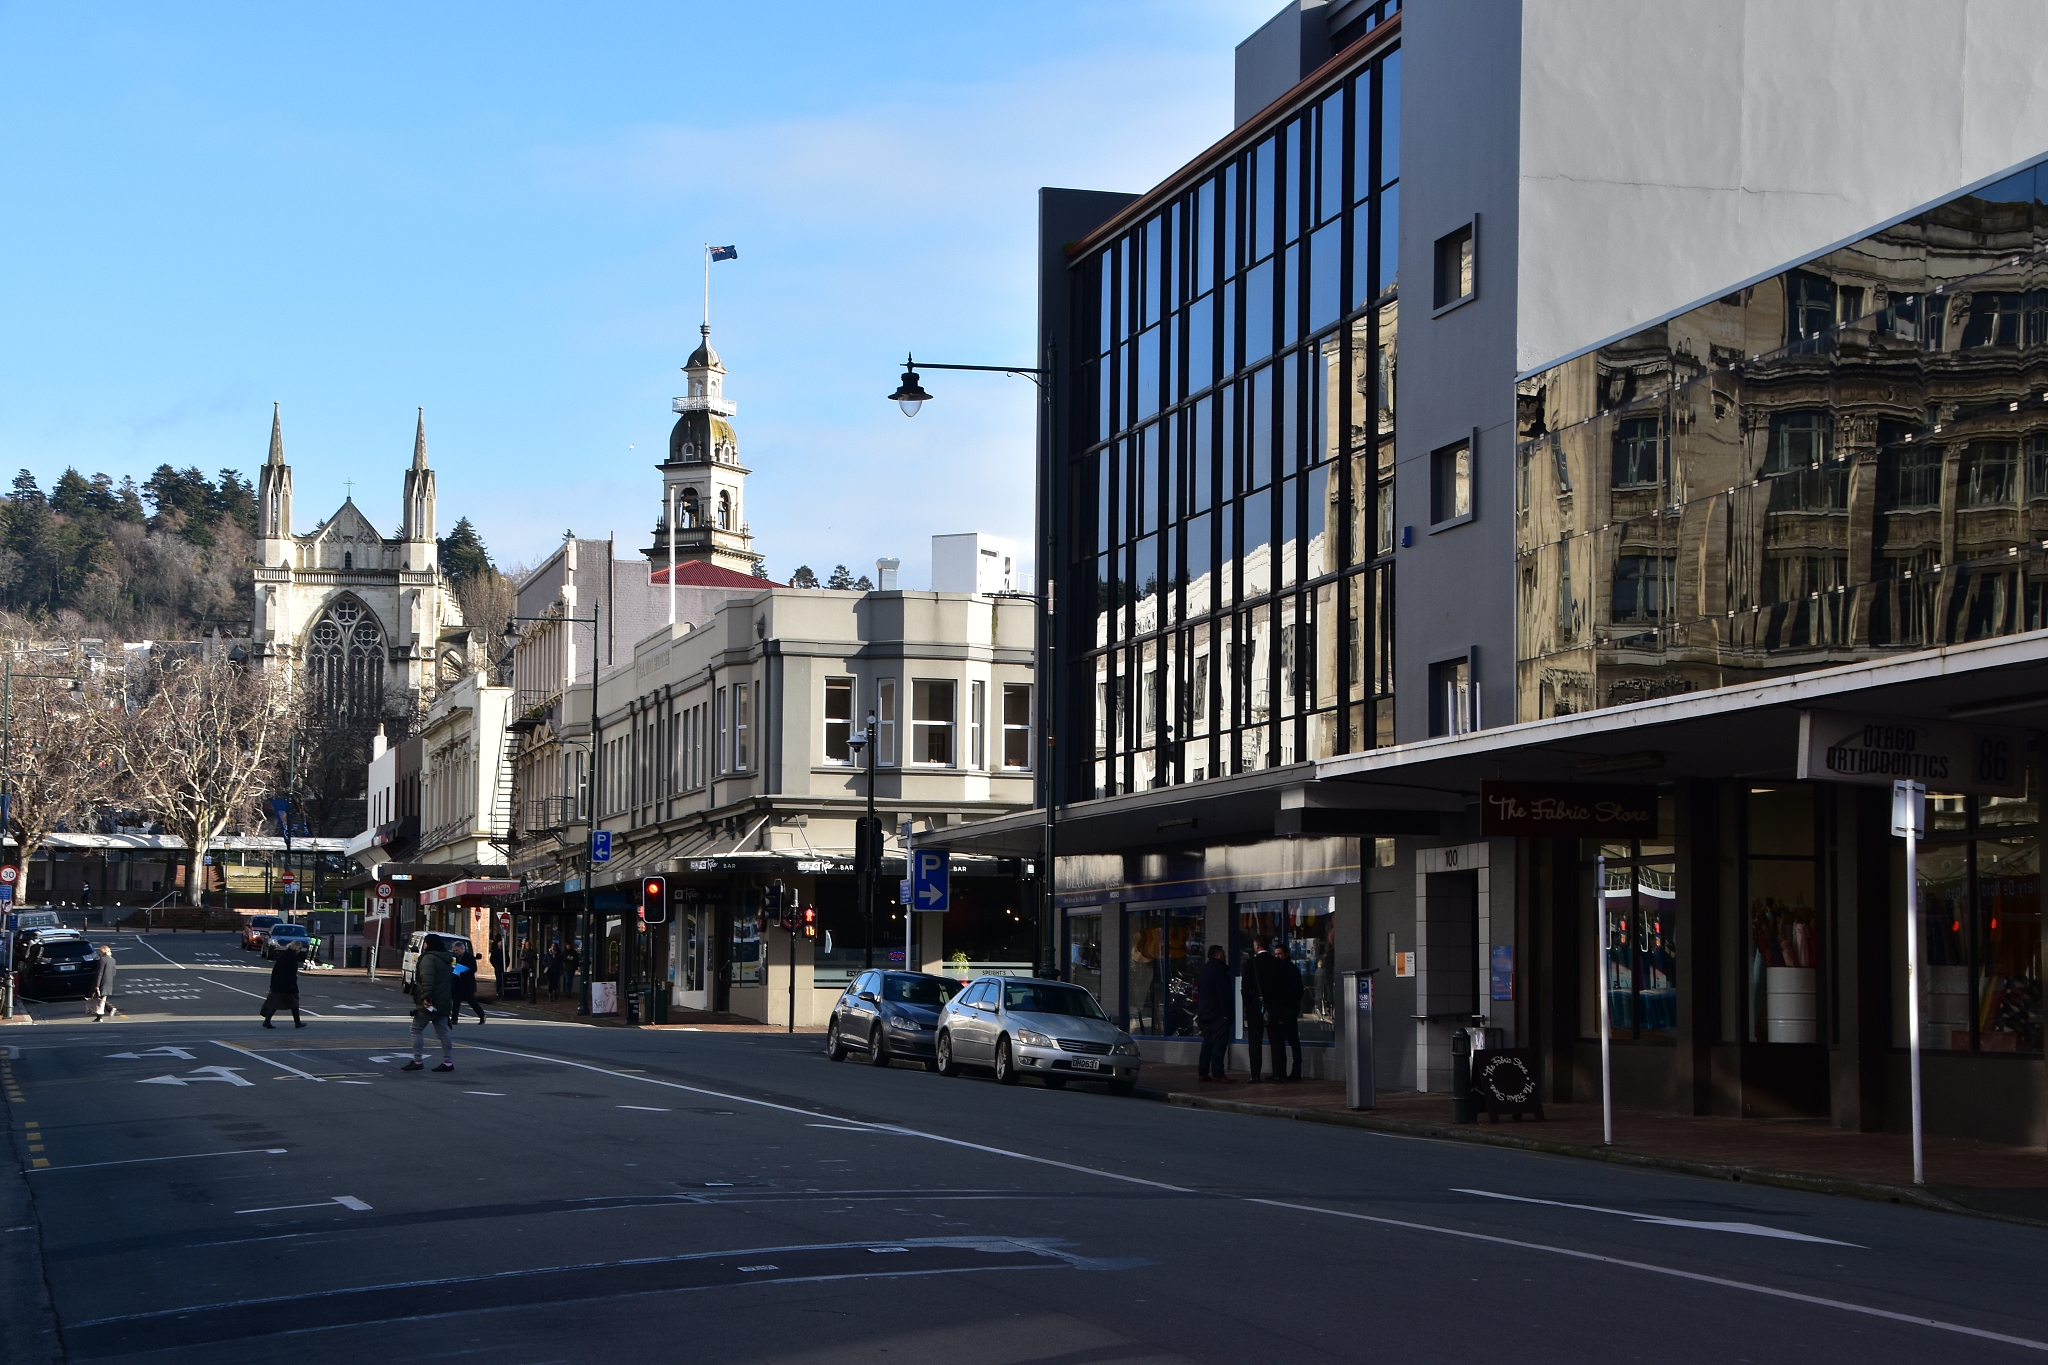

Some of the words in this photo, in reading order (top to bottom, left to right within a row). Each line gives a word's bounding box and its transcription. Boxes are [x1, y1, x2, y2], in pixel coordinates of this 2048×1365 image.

[1864, 725, 1916, 752] OTAGO
[1827, 747, 1949, 779] ORTHODONTICS
[1979, 739, 2007, 781] 86
[1488, 795, 1528, 821] The
[1530, 798, 1590, 820] Fabric
[1595, 801, 1650, 822] Store
[598, 834, 607, 846] P
[921, 854, 942, 880] P
[1445, 849, 1458, 868] 100
[3, 871, 15, 879] 30
[380, 887, 390, 895] 30
[1359, 981, 1368, 993] P
